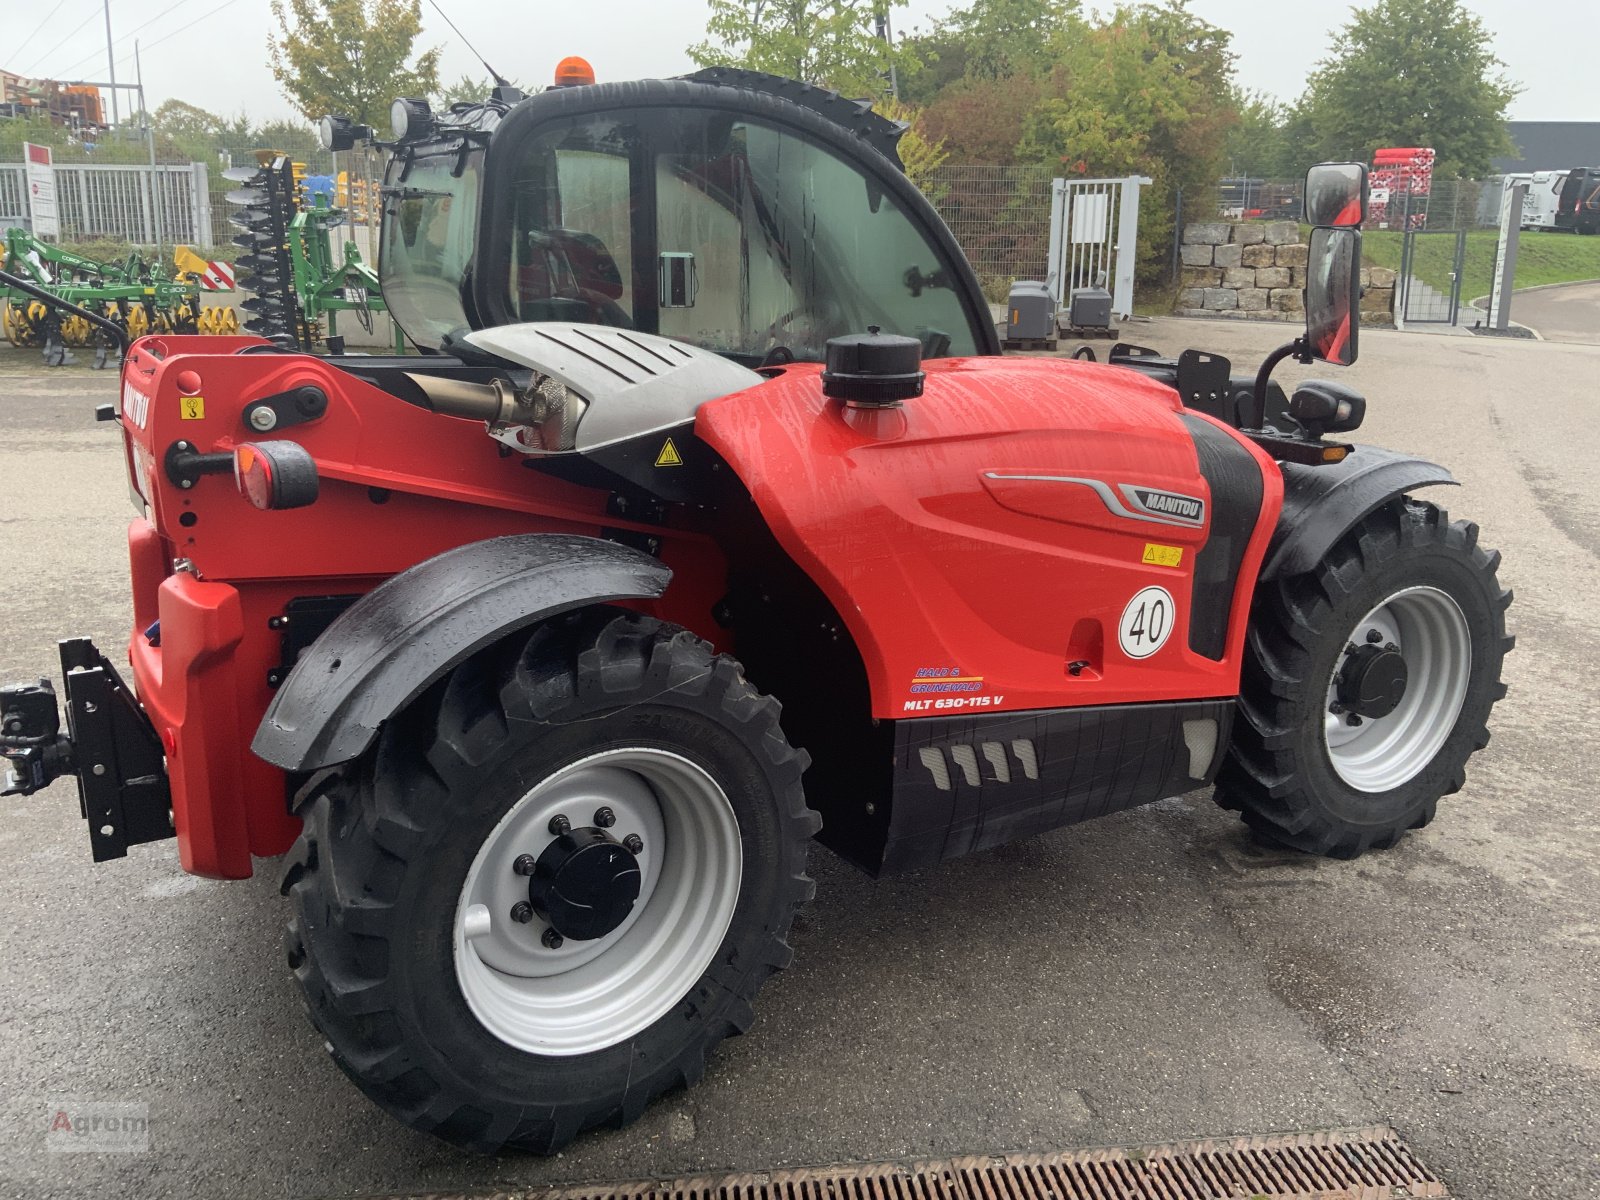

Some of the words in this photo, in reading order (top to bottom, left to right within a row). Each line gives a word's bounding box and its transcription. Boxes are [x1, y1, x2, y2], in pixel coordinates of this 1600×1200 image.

[1145, 493, 1199, 517] MANITOU
[1129, 599, 1165, 646] 40
[916, 667, 949, 677] HALD
[904, 700, 934, 711] MLT
[935, 697, 991, 708] 630-115
[993, 695, 1004, 705] V
